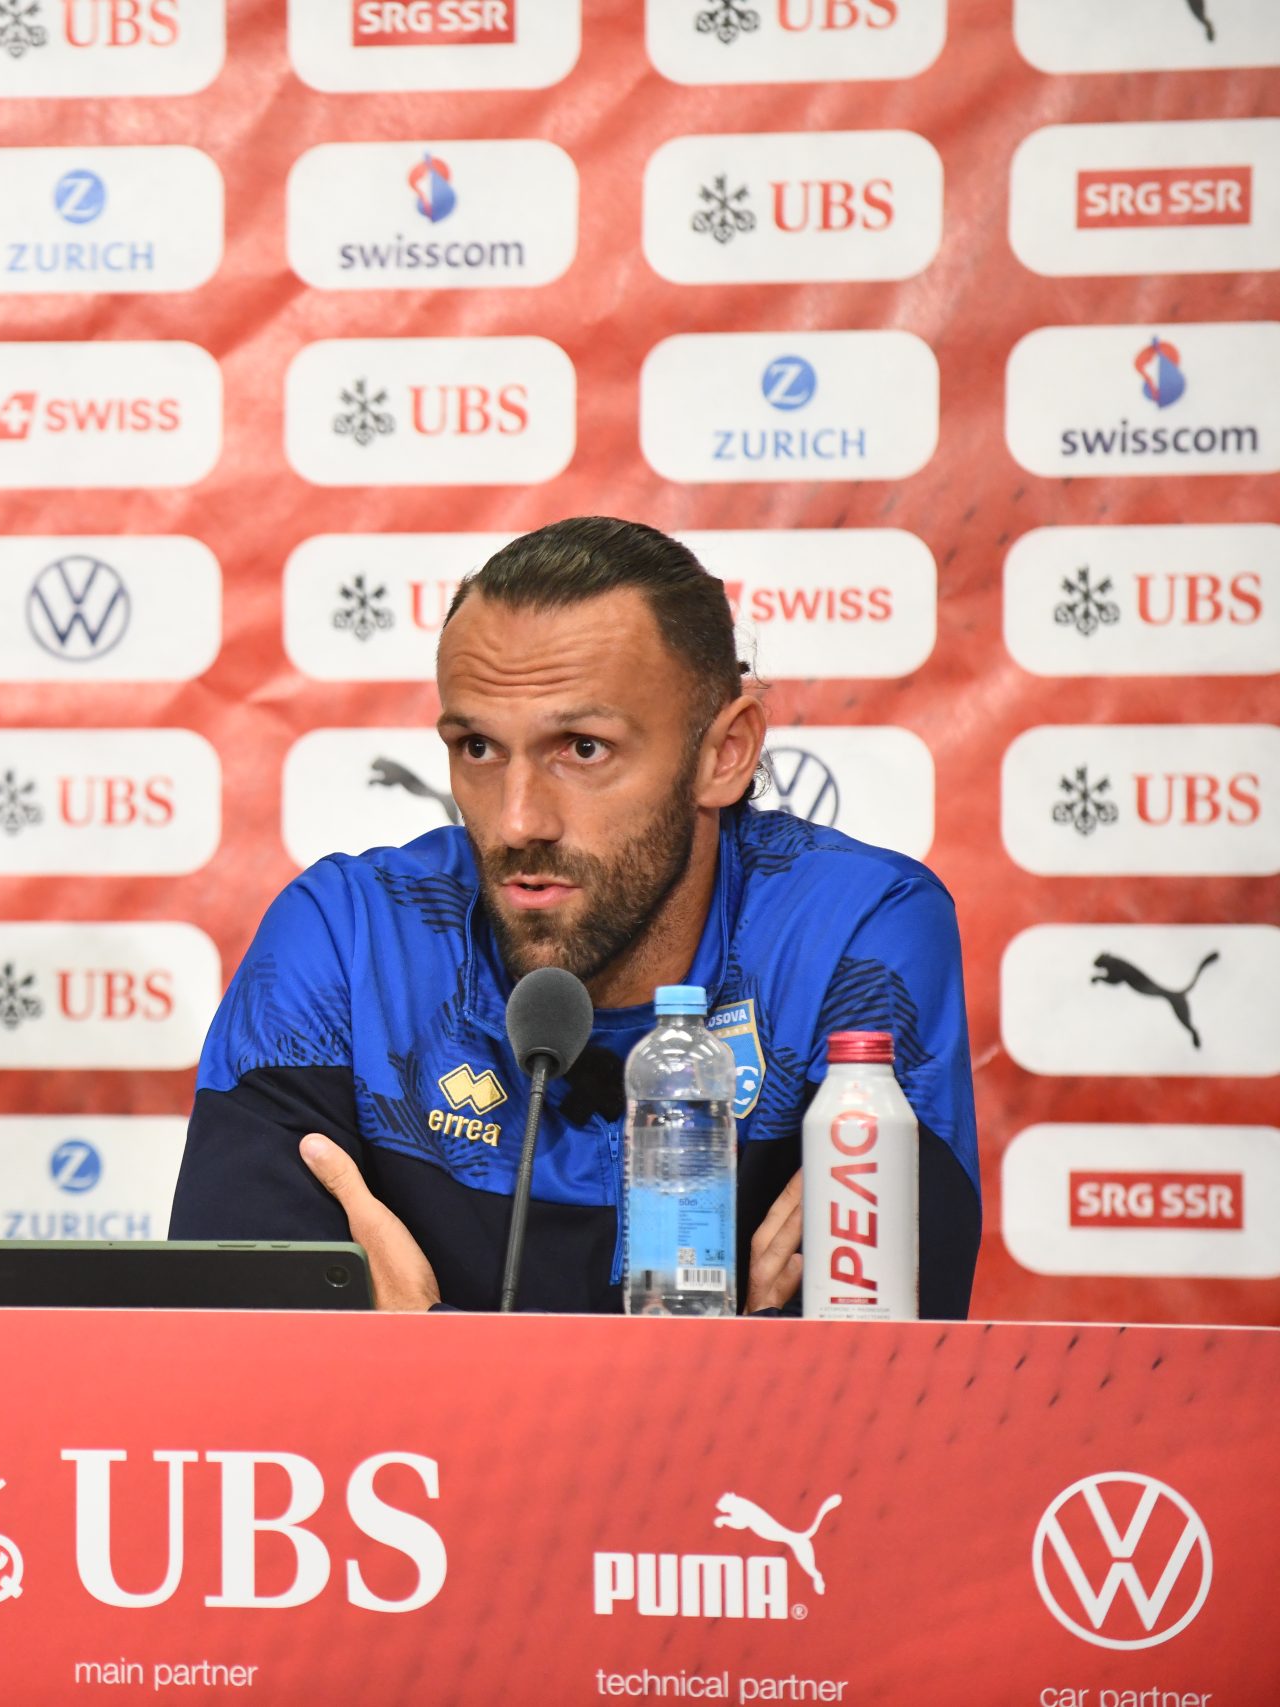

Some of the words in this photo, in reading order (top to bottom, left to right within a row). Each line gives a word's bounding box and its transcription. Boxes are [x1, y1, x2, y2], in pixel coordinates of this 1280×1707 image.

[64, 0, 177, 47] UBS
[358, 4, 432, 33] SRG
[439, 1, 508, 31] SSR
[773, 180, 893, 232] UBS
[1085, 182, 1162, 216] SRG
[1169, 180, 1241, 214] SSR
[7, 243, 155, 271] ZURICH
[340, 235, 523, 269] swisscom
[45, 399, 180, 432] SWISS
[411, 387, 528, 434] UBS
[713, 429, 865, 460] ZURICH
[1062, 420, 1258, 455] swisscom
[752, 588, 892, 621] SWISS
[1137, 574, 1262, 624] UBS
[60, 779, 174, 825] UBS
[1136, 775, 1260, 824] UBS
[58, 971, 172, 1018] UBS
[706, 1009, 747, 1028] OSOVA
[1077, 1182, 1154, 1217] SRG
[1161, 1184, 1233, 1218] SSR
[5, 1210, 152, 1240] ZURICH
[60, 1449, 447, 1613] UBS
[1032, 1471, 1213, 1650] VW
[75, 1657, 143, 1684] main
[154, 1660, 258, 1691] partner
[596, 1669, 728, 1697] technical
[740, 1675, 848, 1704] partner
[1040, 1688, 1089, 1707] car
[1100, 1687, 1212, 1707] partner
